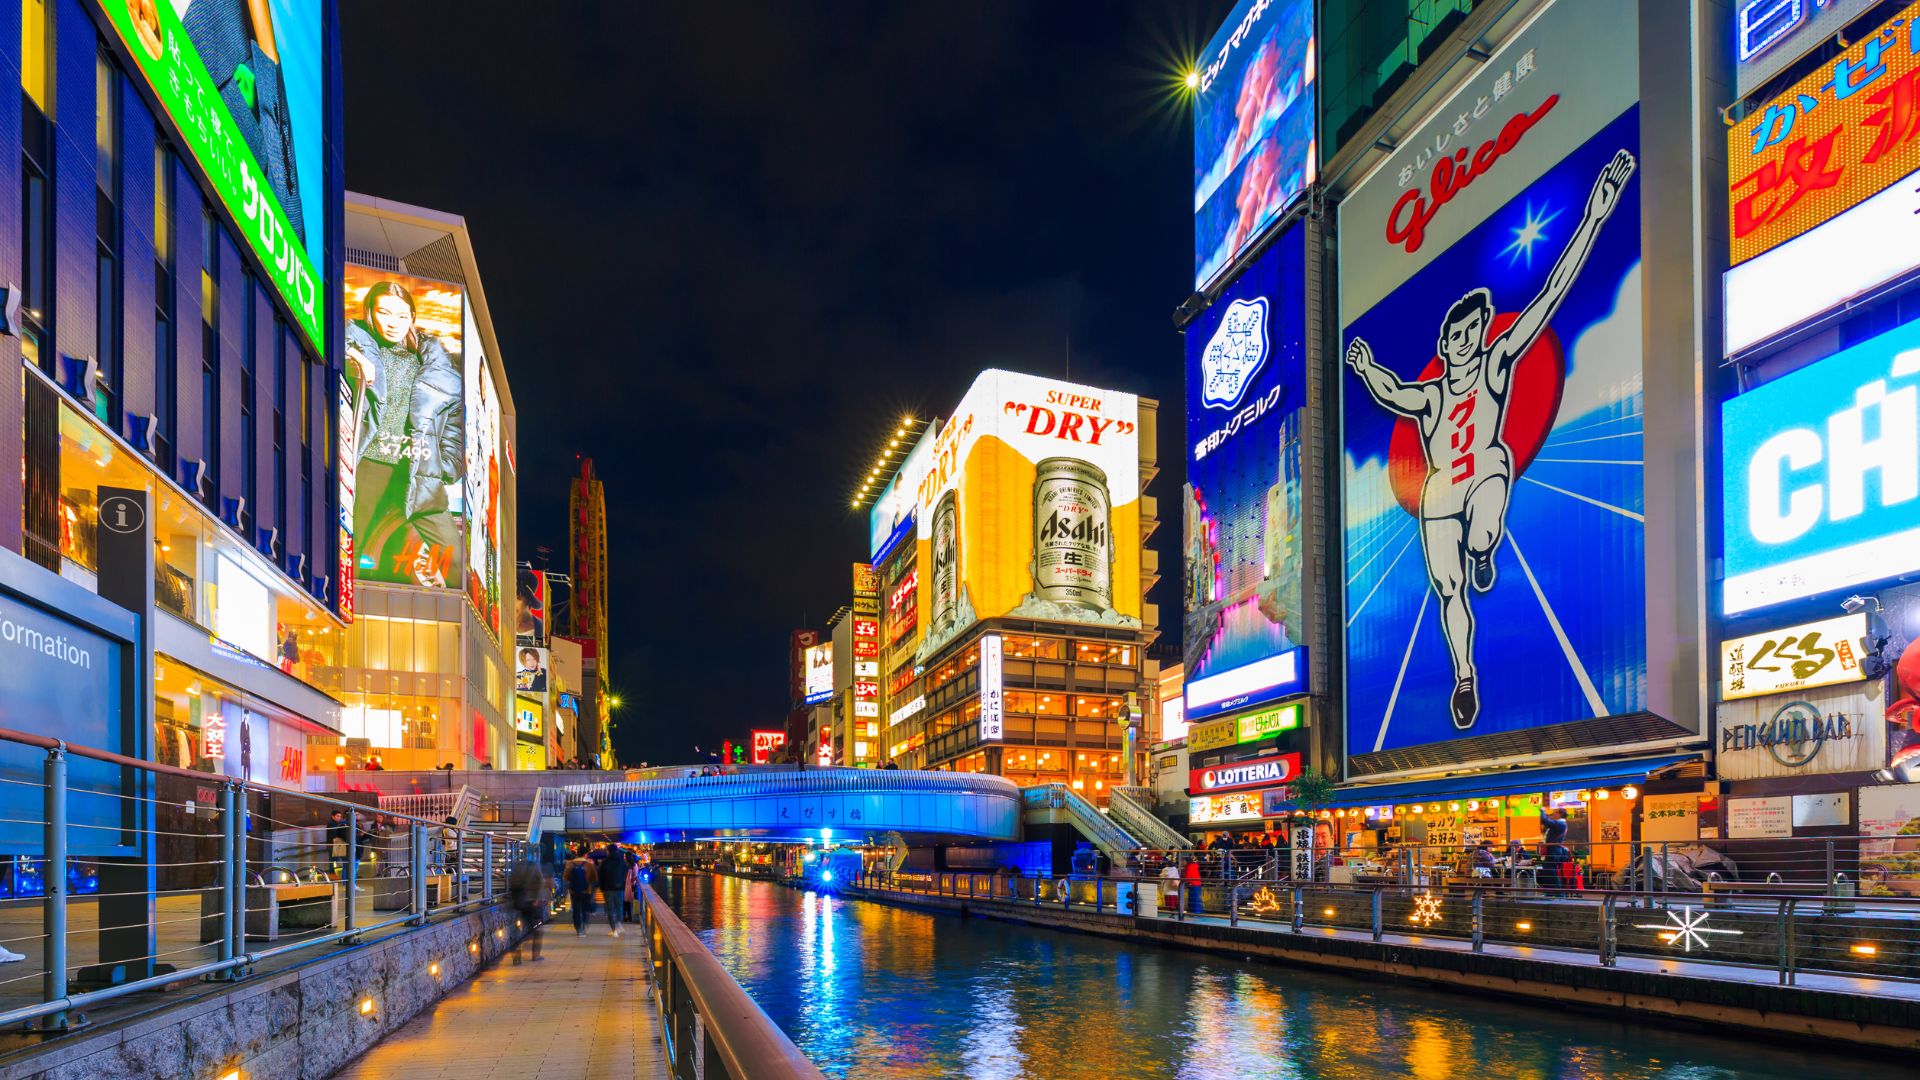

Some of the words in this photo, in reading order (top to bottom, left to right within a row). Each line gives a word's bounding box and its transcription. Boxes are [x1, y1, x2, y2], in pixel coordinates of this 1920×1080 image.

[1398, 48, 1537, 187] おいしさと健康
[1386, 93, 1560, 253] Glico
[239, 158, 317, 327] サロンパス
[1046, 389, 1101, 412] SUPER
[1195, 384, 1281, 461] 雪印メグミルク
[1447, 388, 1478, 486] グリコ
[1040, 509, 1105, 548] Asahi
[1055, 566, 1093, 578] スーパードライ
[1064, 552, 1083, 567] 生
[0, 611, 91, 670] ormation
[1746, 631, 1836, 681] くくる
[1728, 643, 1746, 691] 道頓堀
[1774, 680, 1805, 690] KUKURU
[1811, 711, 1852, 743] BAR
[1217, 762, 1280, 785] LOTTERIA
[1428, 832, 1457, 846] お好み
